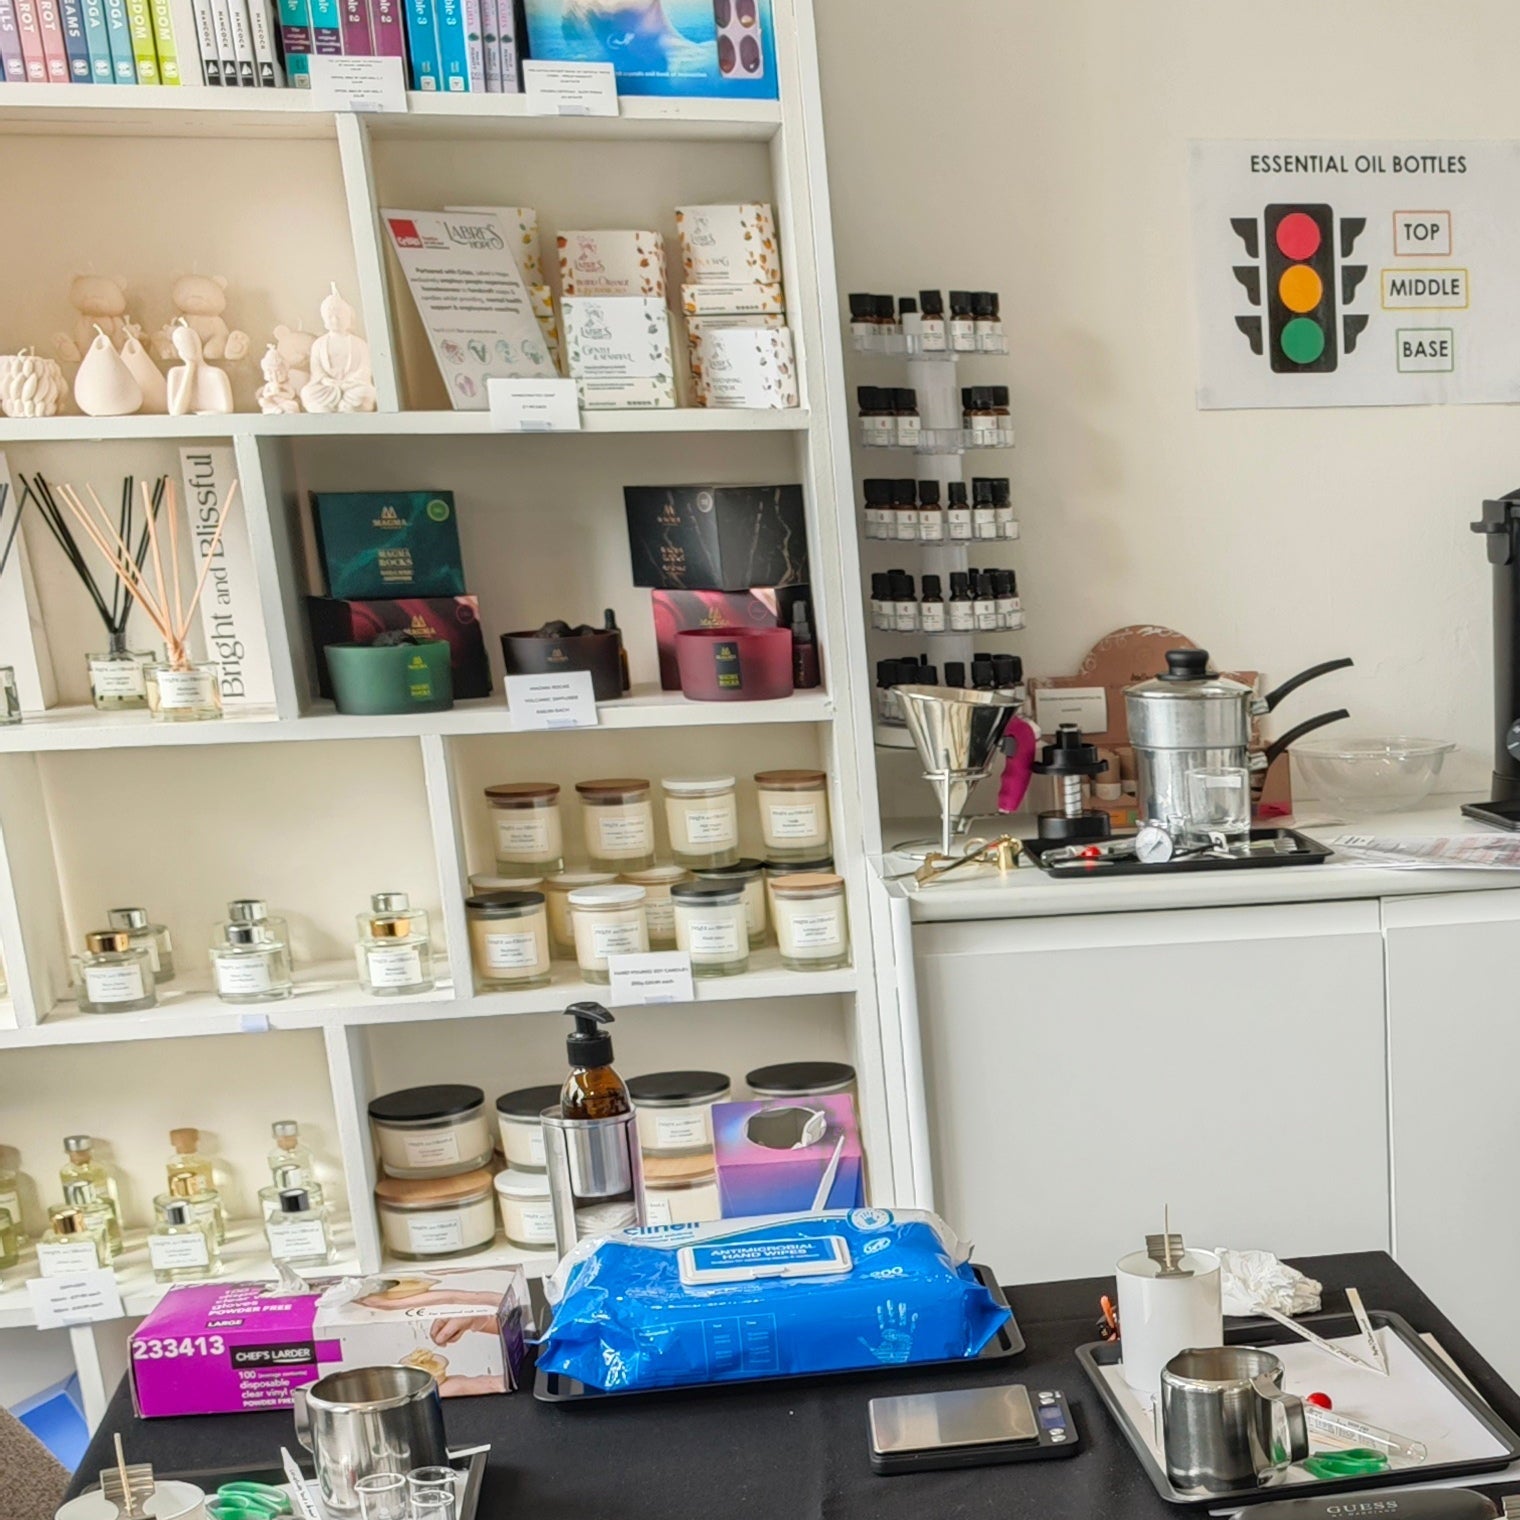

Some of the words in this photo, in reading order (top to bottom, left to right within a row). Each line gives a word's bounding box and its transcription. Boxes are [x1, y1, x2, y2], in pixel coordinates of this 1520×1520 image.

[20, 0, 35, 32] ROT
[1250, 155, 1349, 174] ESSENTIAL
[1355, 155, 1386, 174] OIL
[1392, 155, 1468, 174] BOTTLES
[1404, 223, 1440, 241] TOP
[1389, 278, 1461, 297] MIDDLE
[1402, 340, 1449, 358] BASE
[186, 452, 225, 560] Blissful
[209, 567, 231, 606] and
[211, 611, 246, 698] Bright
[710, 1244, 815, 1257] ANTIMICROBIAL
[722, 1250, 764, 1260] HAND
[764, 1248, 808, 1258] WIPES
[208, 1305, 262, 1316] POWDER
[207, 1319, 243, 1328] LARGE
[132, 1335, 226, 1360] 233413
[235, 1351, 271, 1362] CHEF'S
[271, 1347, 311, 1360] LARDER
[238, 1371, 256, 1380] 100
[239, 1379, 291, 1391] disposable
[241, 1389, 264, 1399] clear
[265, 1388, 289, 1399] vinyl
[242, 1398, 277, 1408] POWDER
[1325, 1500, 1399, 1516] GUESS
